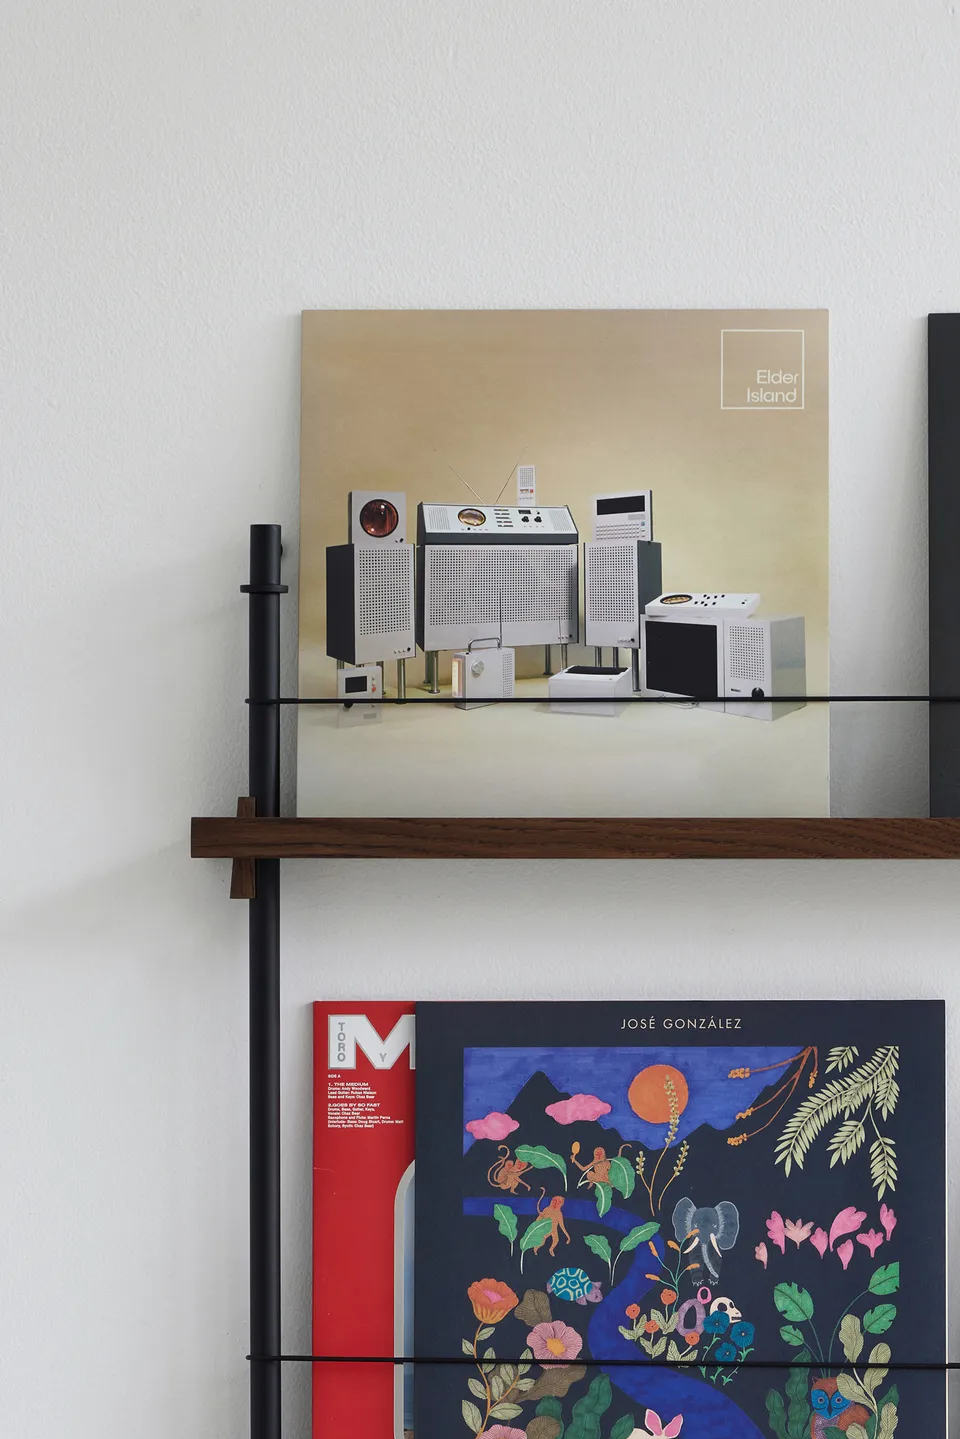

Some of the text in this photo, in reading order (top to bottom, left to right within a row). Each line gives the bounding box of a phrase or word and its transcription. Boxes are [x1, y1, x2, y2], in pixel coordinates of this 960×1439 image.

[756, 369, 799, 384] Elder
[747, 388, 797, 403] Island
[620, 1015, 742, 1029] JOSÉ GONZÁLEZ
[337, 1022, 346, 1062] TORO
[379, 1053, 387, 1062] Y
